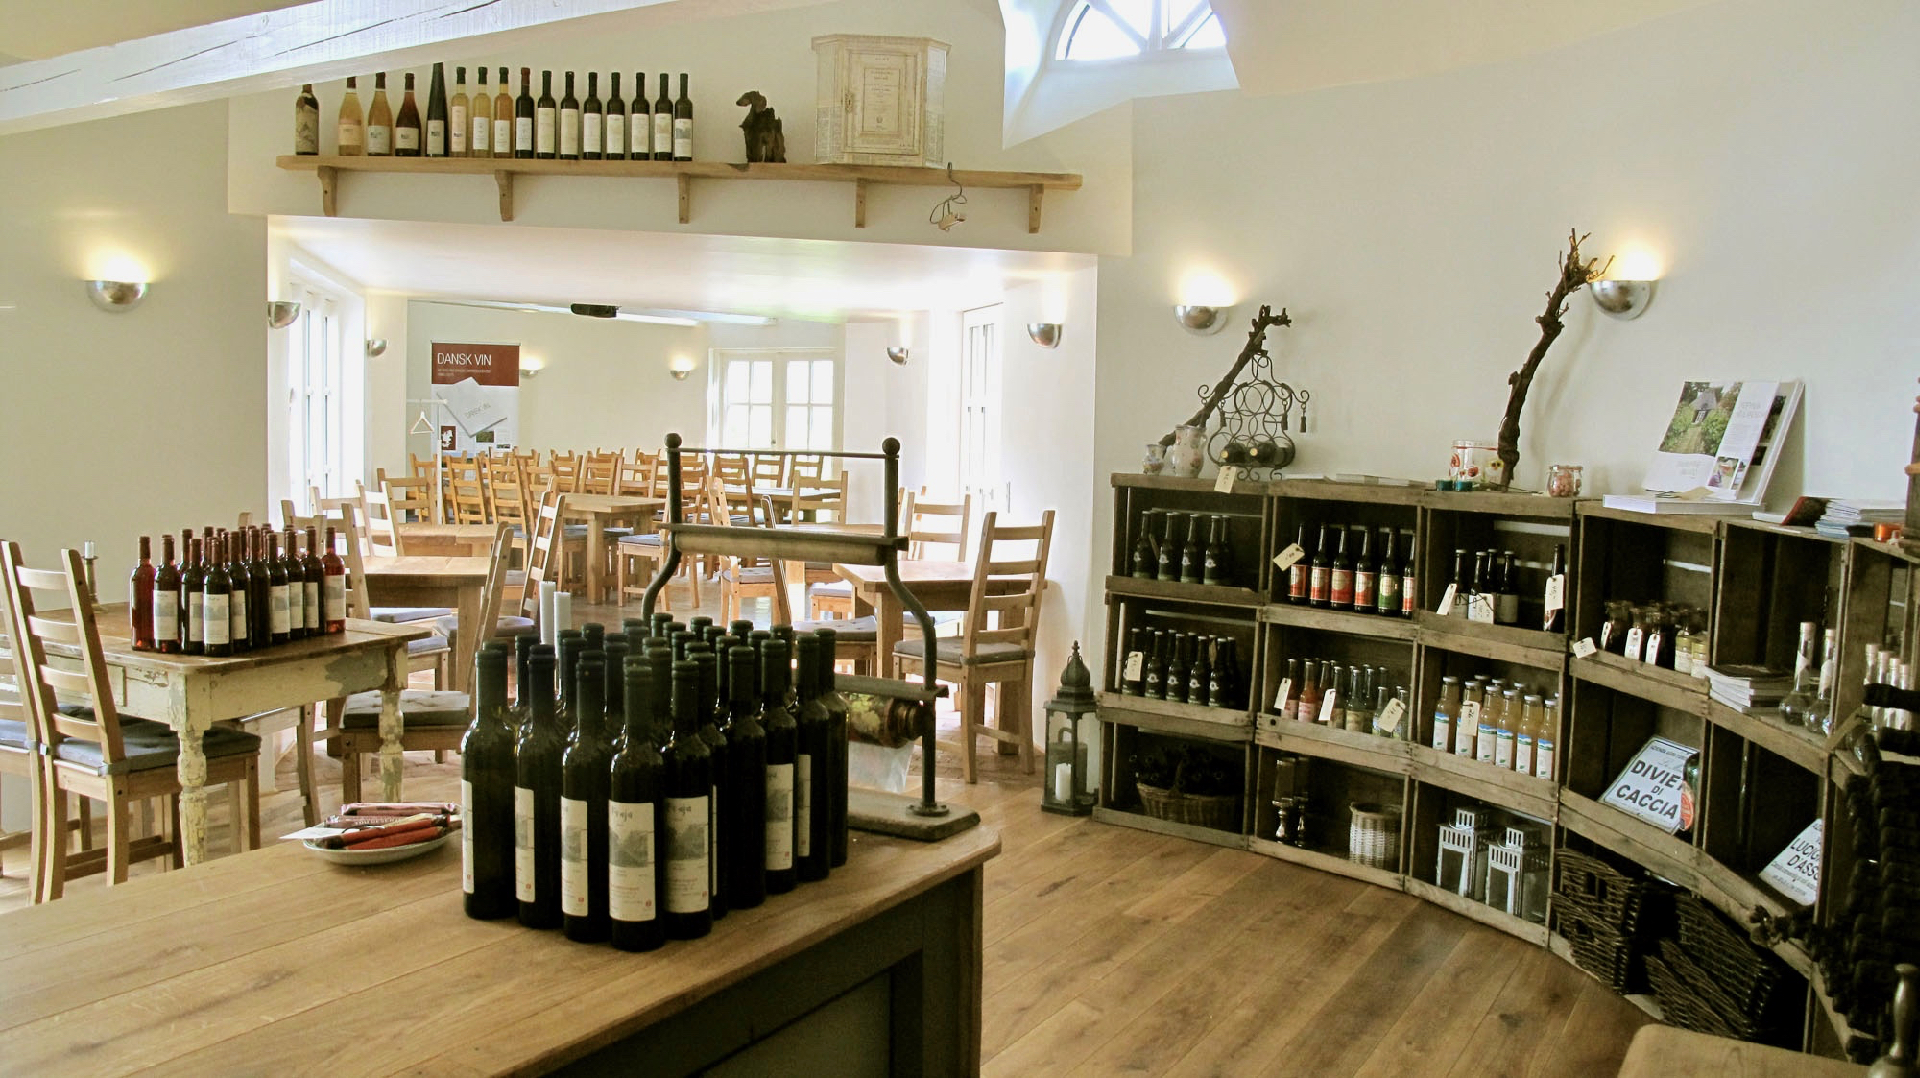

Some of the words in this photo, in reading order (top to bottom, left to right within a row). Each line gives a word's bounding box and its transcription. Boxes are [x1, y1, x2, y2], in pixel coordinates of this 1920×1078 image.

[437, 352, 473, 366] DANSK
[474, 353, 492, 367] VIN
[1651, 785, 1664, 796] DI
[1616, 784, 1679, 820] CACCIA
